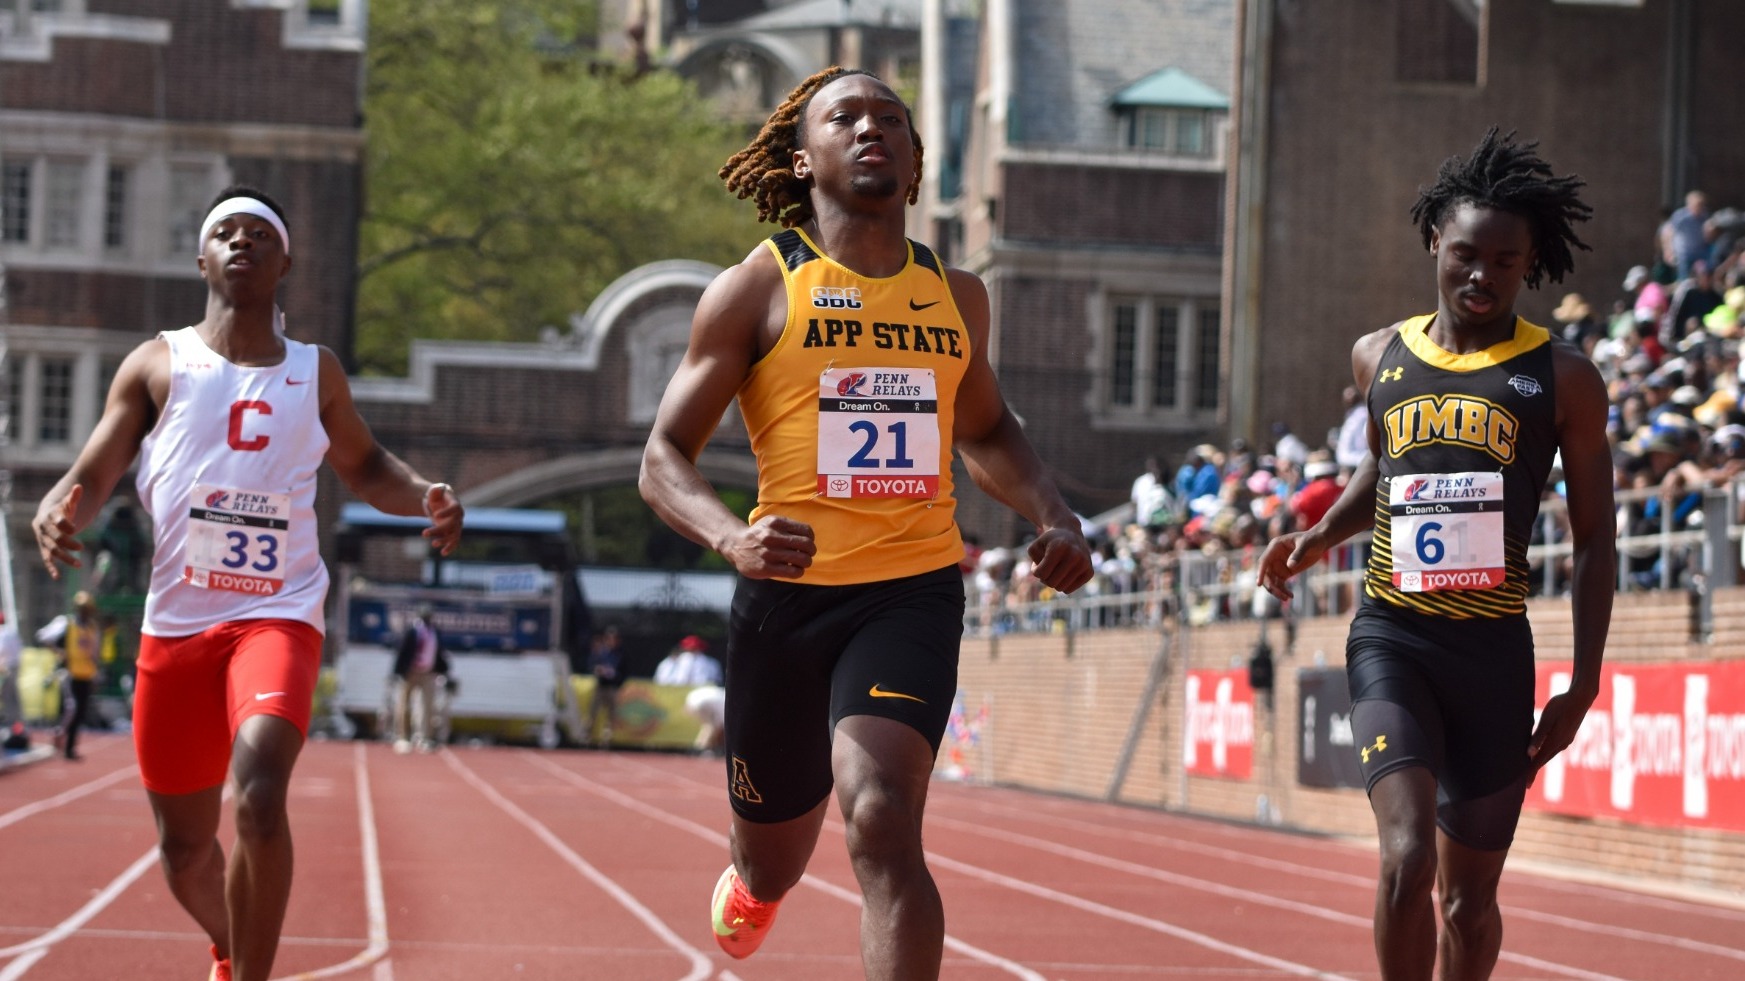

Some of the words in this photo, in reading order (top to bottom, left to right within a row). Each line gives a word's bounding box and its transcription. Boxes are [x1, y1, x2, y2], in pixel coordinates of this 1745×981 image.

[811, 286, 863, 310] SBC
[803, 318, 862, 348] APP
[873, 322, 962, 359] STATE
[873, 373, 909, 384] PENN
[871, 385, 921, 396] RELAYS
[839, 401, 872, 411] Dream
[873, 401, 890, 411] On.
[227, 400, 273, 451] C
[1386, 396, 1517, 462] UMBC
[847, 420, 914, 468] 21
[856, 479, 927, 494] TOYOTA
[1436, 478, 1475, 488] PENN
[235, 492, 270, 504] PENN
[1434, 488, 1487, 499] RELAYS
[232, 502, 279, 514] RELAYS
[1405, 505, 1435, 515] Dream
[1435, 504, 1452, 513] On.
[205, 511, 231, 523] Dream
[211, 573, 274, 594] TOYOTA
[1425, 572, 1491, 587] TOYOTA
[732, 755, 763, 803] A
